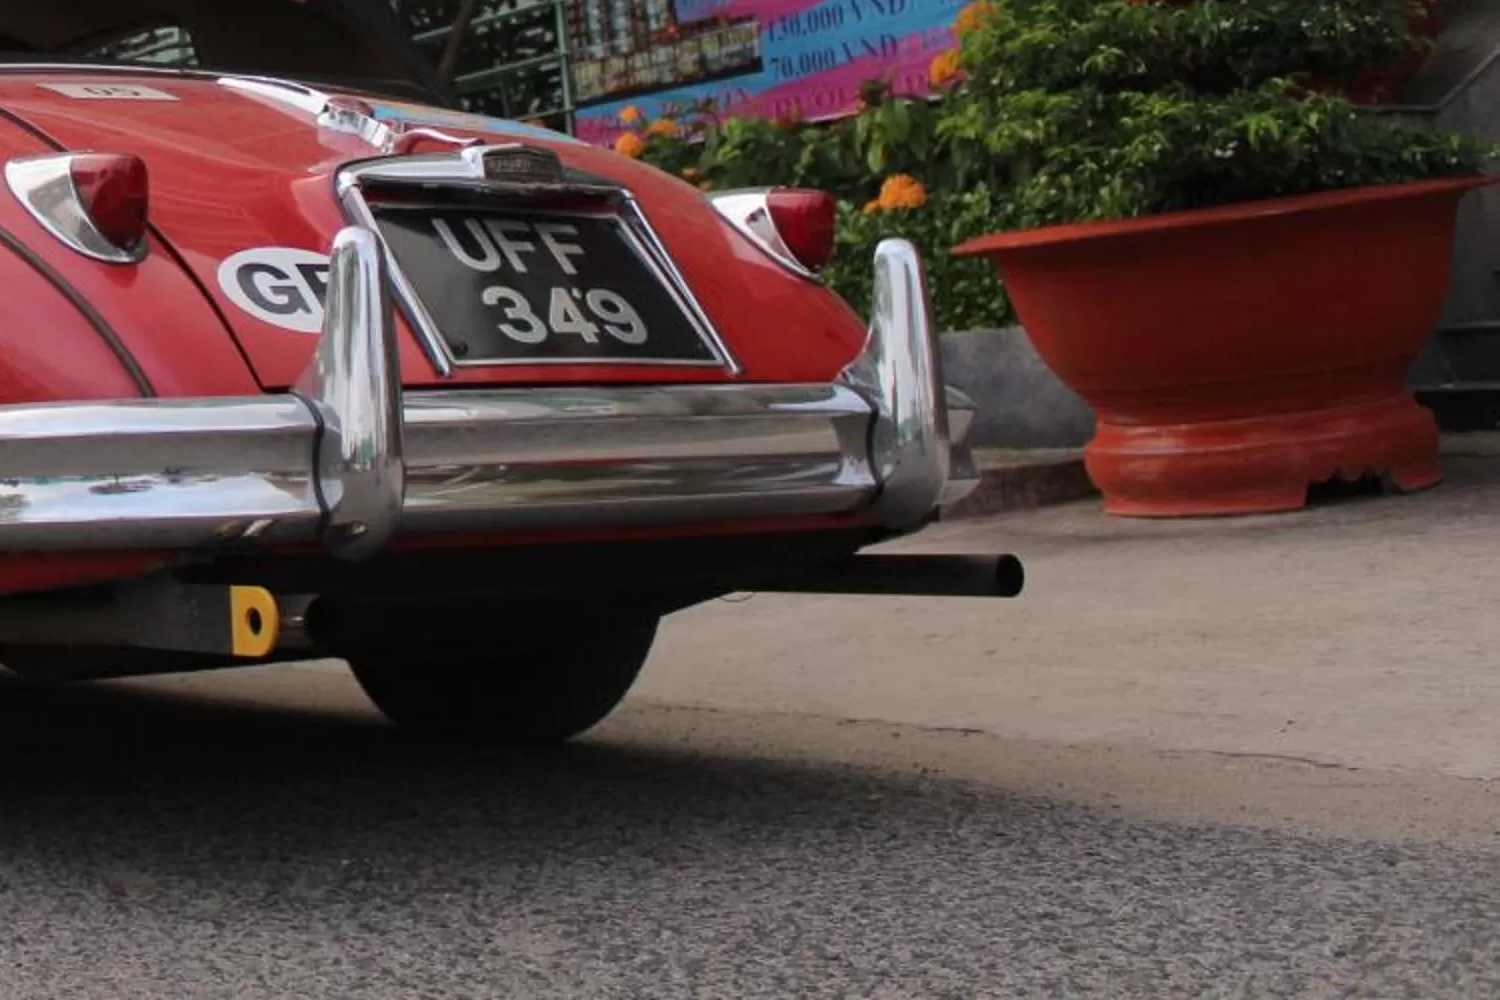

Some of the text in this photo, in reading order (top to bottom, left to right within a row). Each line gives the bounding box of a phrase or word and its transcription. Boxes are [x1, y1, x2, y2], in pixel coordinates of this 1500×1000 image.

[842, 33, 898, 64] VND
[432, 217, 584, 275] UFF
[482, 287, 648, 345] 349
